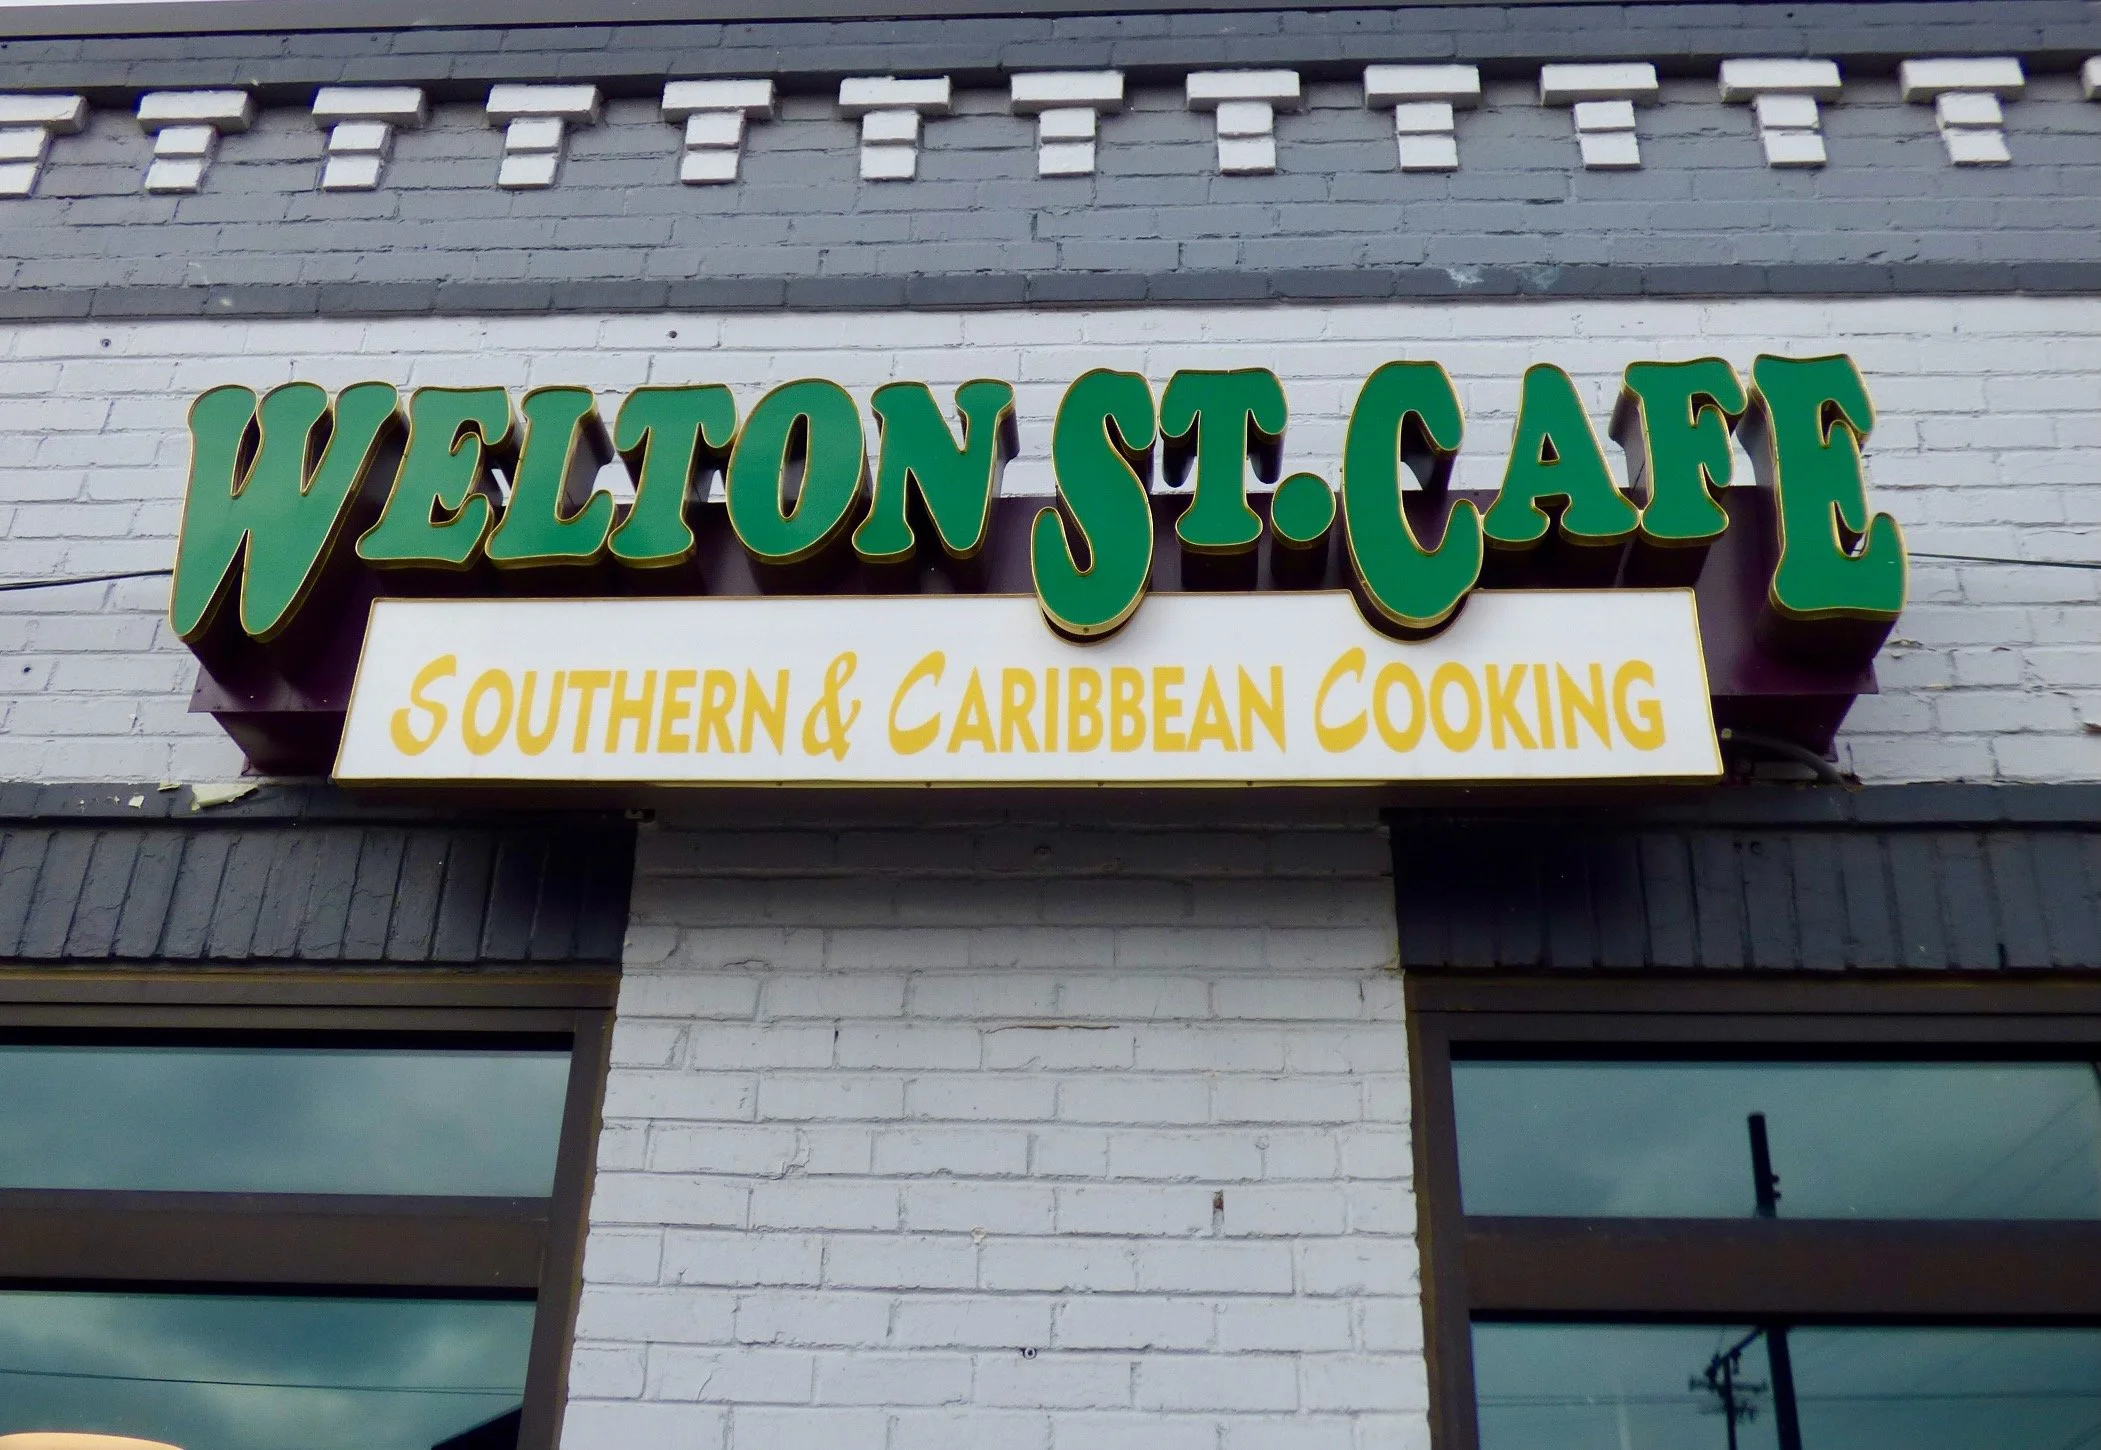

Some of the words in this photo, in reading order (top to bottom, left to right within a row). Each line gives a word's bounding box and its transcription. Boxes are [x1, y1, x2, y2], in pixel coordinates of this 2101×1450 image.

[172, 379, 1015, 637] WELTON
[1032, 369, 1338, 637] ST.
[1342, 352, 1906, 631] CAFE
[390, 655, 791, 758] SOUTHERN
[801, 650, 862, 763] &
[888, 650, 1288, 758] CARIBBEAN
[1314, 646, 1668, 754] COOKING
